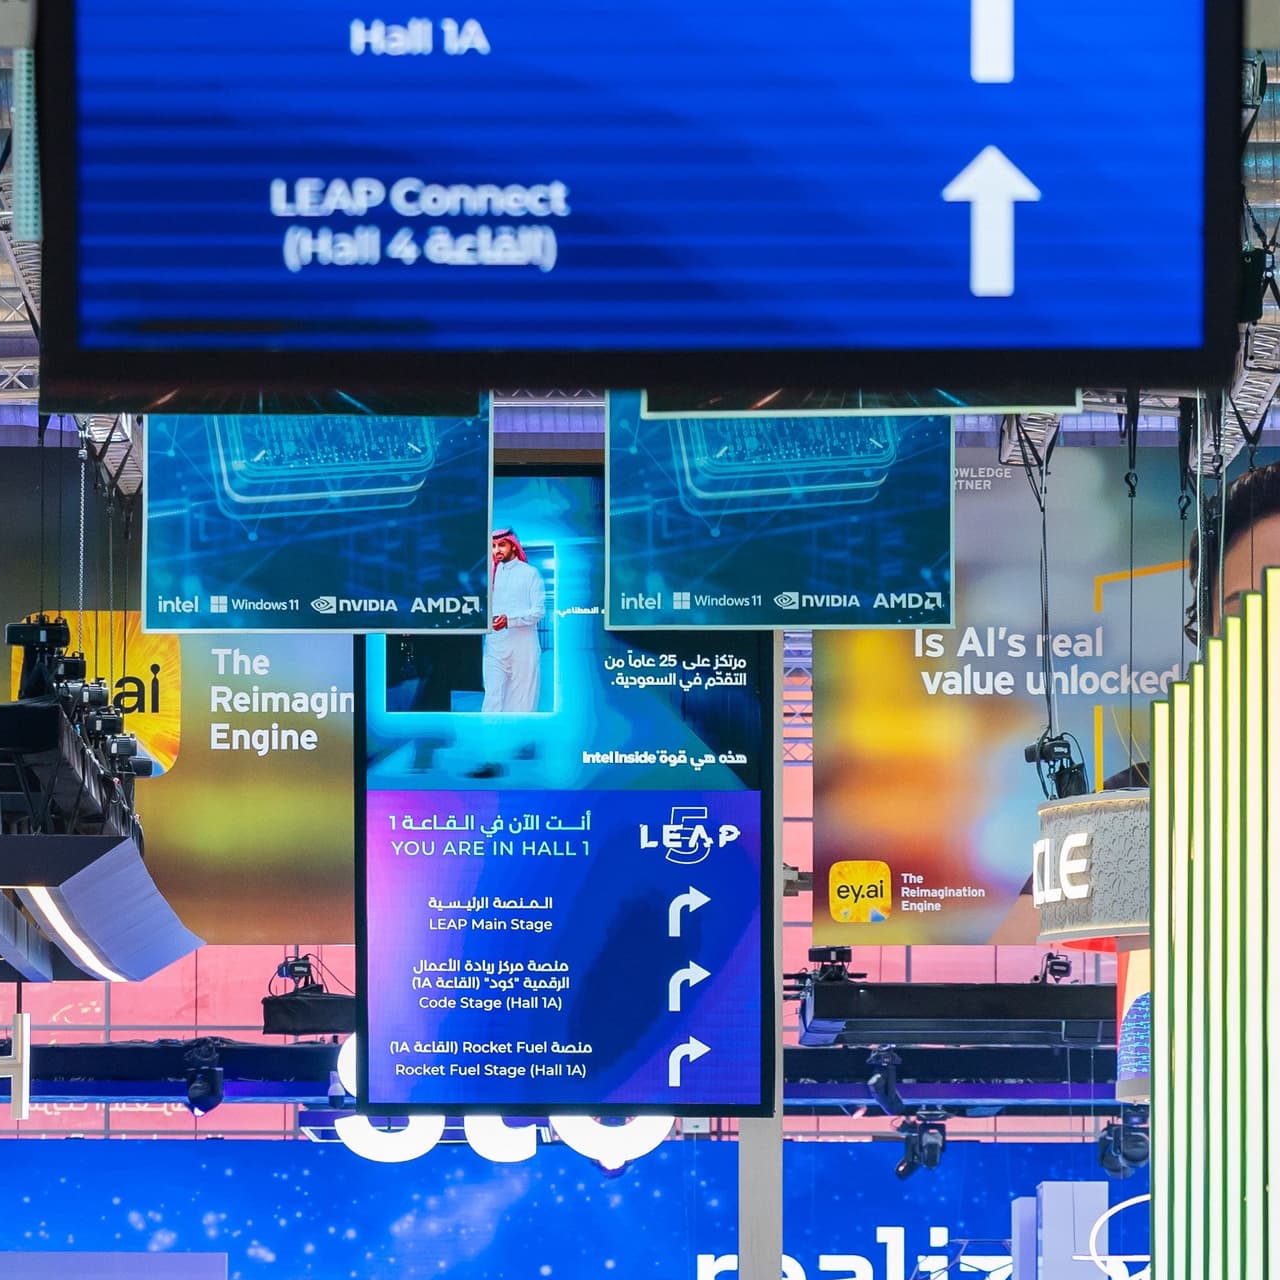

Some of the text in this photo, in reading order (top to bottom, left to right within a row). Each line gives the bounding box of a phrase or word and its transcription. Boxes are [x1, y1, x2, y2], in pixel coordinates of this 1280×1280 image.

[350, 17, 491, 55] Hall 1A
[271, 177, 570, 216] LEAP Connect
[283, 225, 381, 272] (Hall
[386, 225, 420, 265] 4
[158, 596, 199, 613] intel
[231, 599, 299, 611] Windows 11
[410, 597, 461, 613] AMD
[621, 592, 661, 609] intel
[694, 594, 762, 607] Windows 11
[873, 592, 924, 609] AMD
[914, 626, 1103, 658] Is AI's real
[211, 648, 270, 675] The
[604, 655, 625, 670] من
[659, 654, 678, 667] 25
[682, 654, 711, 670] على
[712, 654, 747, 670] مرتكز
[679, 672, 702, 691] في
[921, 663, 1014, 695] value
[210, 722, 318, 757] Engine
[659, 750, 687, 767] قوة
[689, 754, 716, 771] هي
[718, 750, 748, 764] هذه
[389, 815, 397, 831] 1
[480, 815, 504, 838] في
[508, 813, 540, 834] الآن
[639, 823, 741, 849] LEAP
[391, 840, 590, 856] YOU ARE IN HALL 1
[901, 873, 923, 884] The
[836, 880, 884, 903] ey.ai
[901, 886, 985, 899] Reimagination
[901, 900, 941, 913] Engine
[429, 918, 553, 933] LEAP Main Stage
[413, 958, 569, 975] منصة مركز ريادة الأعمال
[522, 976, 570, 992] الرقمية
[419, 996, 562, 1011] Code Stage (Hall 1A)
[462, 1041, 512, 1053] Rocket
[516, 1041, 547, 1053] Fuel
[551, 1041, 593, 1054] منصة
[395, 1063, 586, 1078] Rocket Fuel Stage (Hall 1A)
